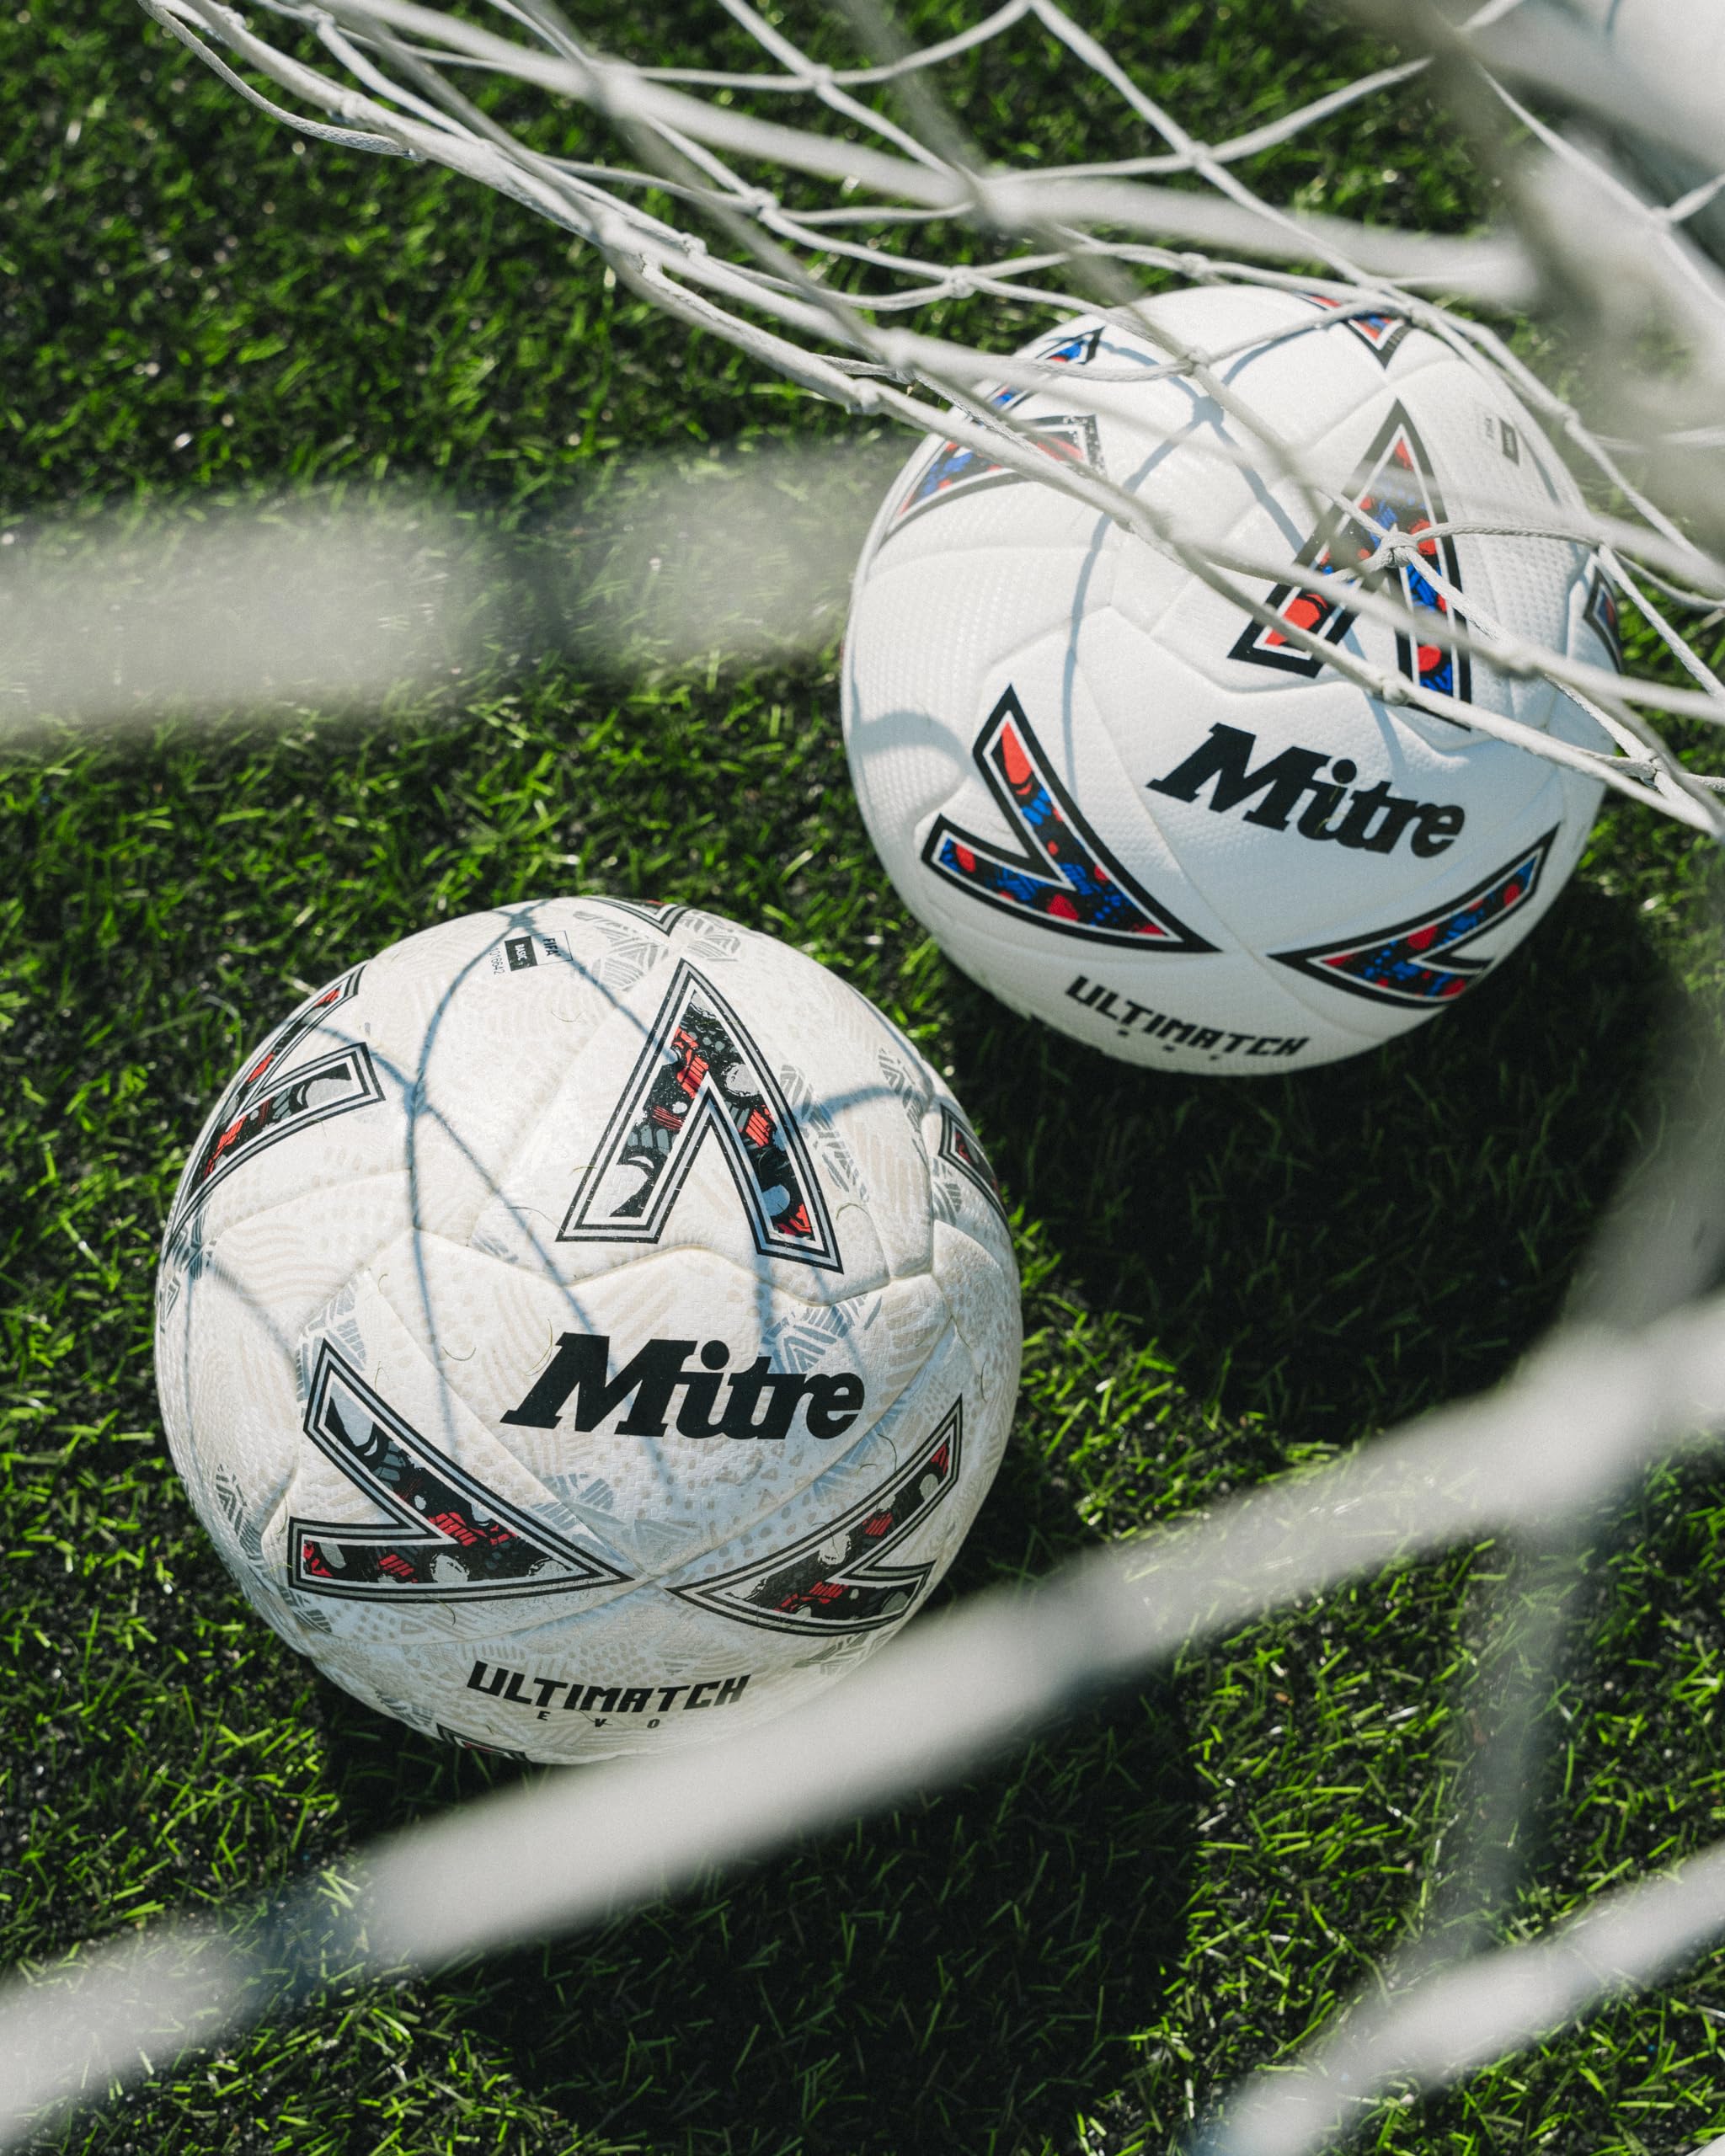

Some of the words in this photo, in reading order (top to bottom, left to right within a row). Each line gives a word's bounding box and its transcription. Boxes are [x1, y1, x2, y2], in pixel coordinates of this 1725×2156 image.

[1146, 723, 1465, 858] Mitre
[515, 943, 528, 961] BASIC
[1065, 974, 1310, 1056] ULTIMATCH
[499, 1331, 865, 1440] Mitre
[467, 1660, 751, 1713] ULTIMATCH
